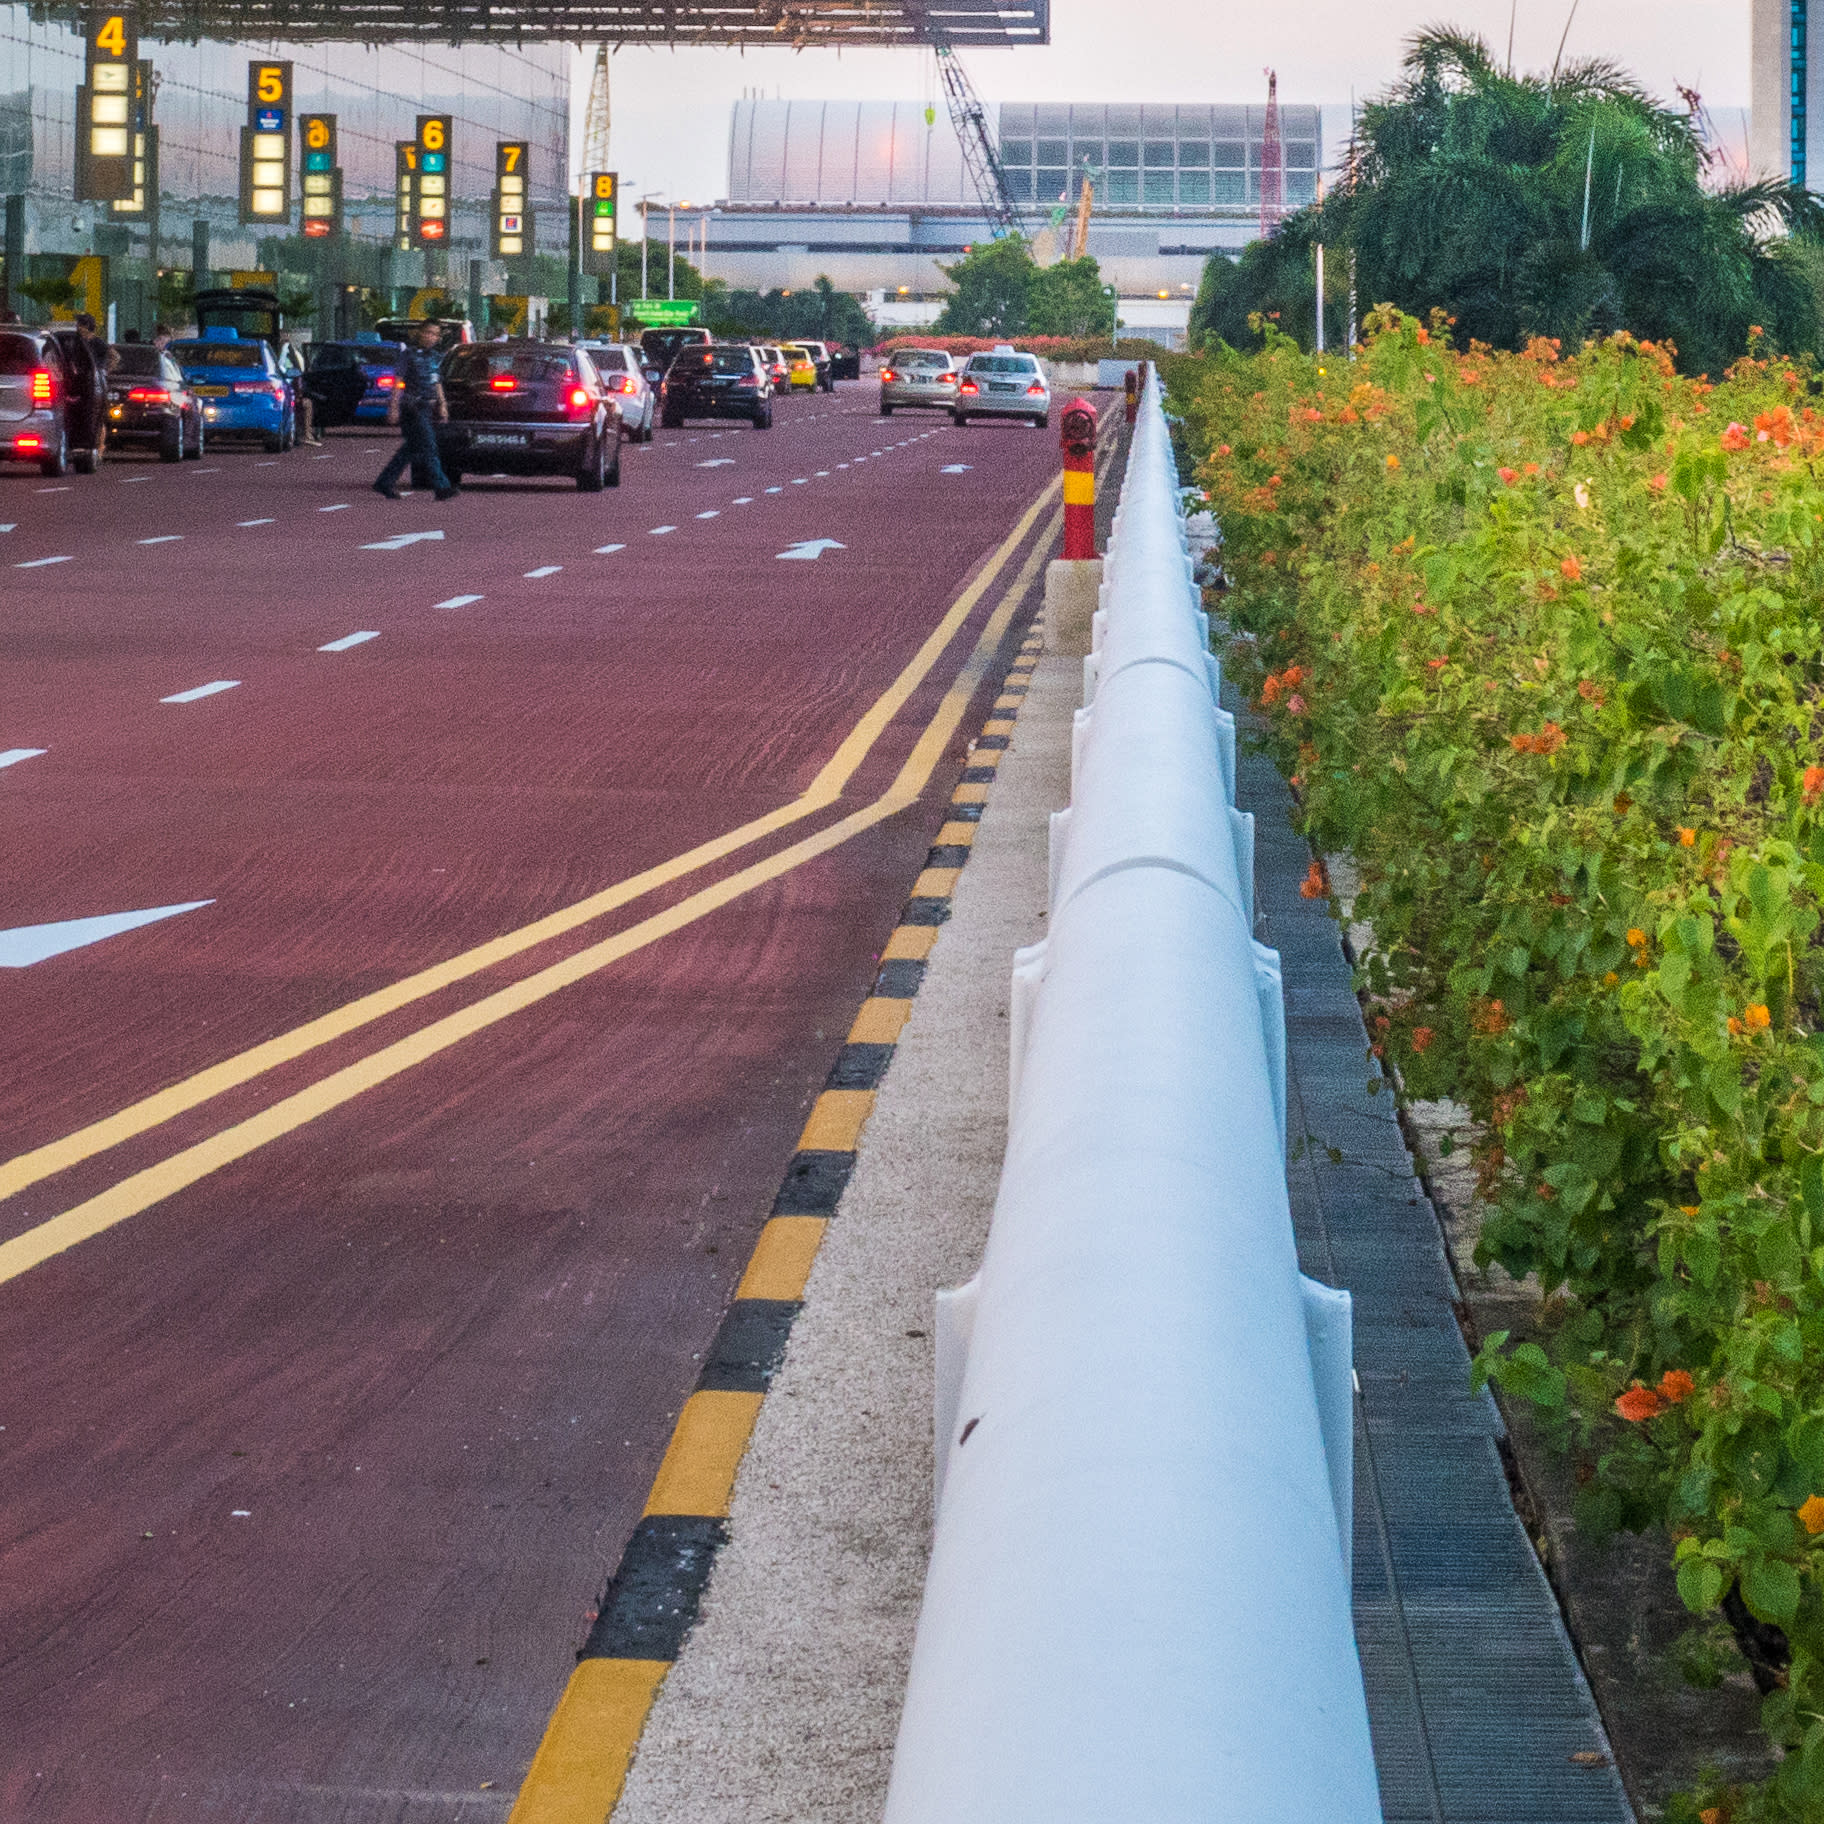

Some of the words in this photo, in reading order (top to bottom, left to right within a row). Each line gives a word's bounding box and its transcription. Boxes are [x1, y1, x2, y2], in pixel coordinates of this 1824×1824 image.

[96, 16, 126, 56] 4
[257, 67, 283, 103] 5
[422, 119, 444, 151] 6
[503, 146, 521, 173] 7
[596, 175, 613, 198] 8
